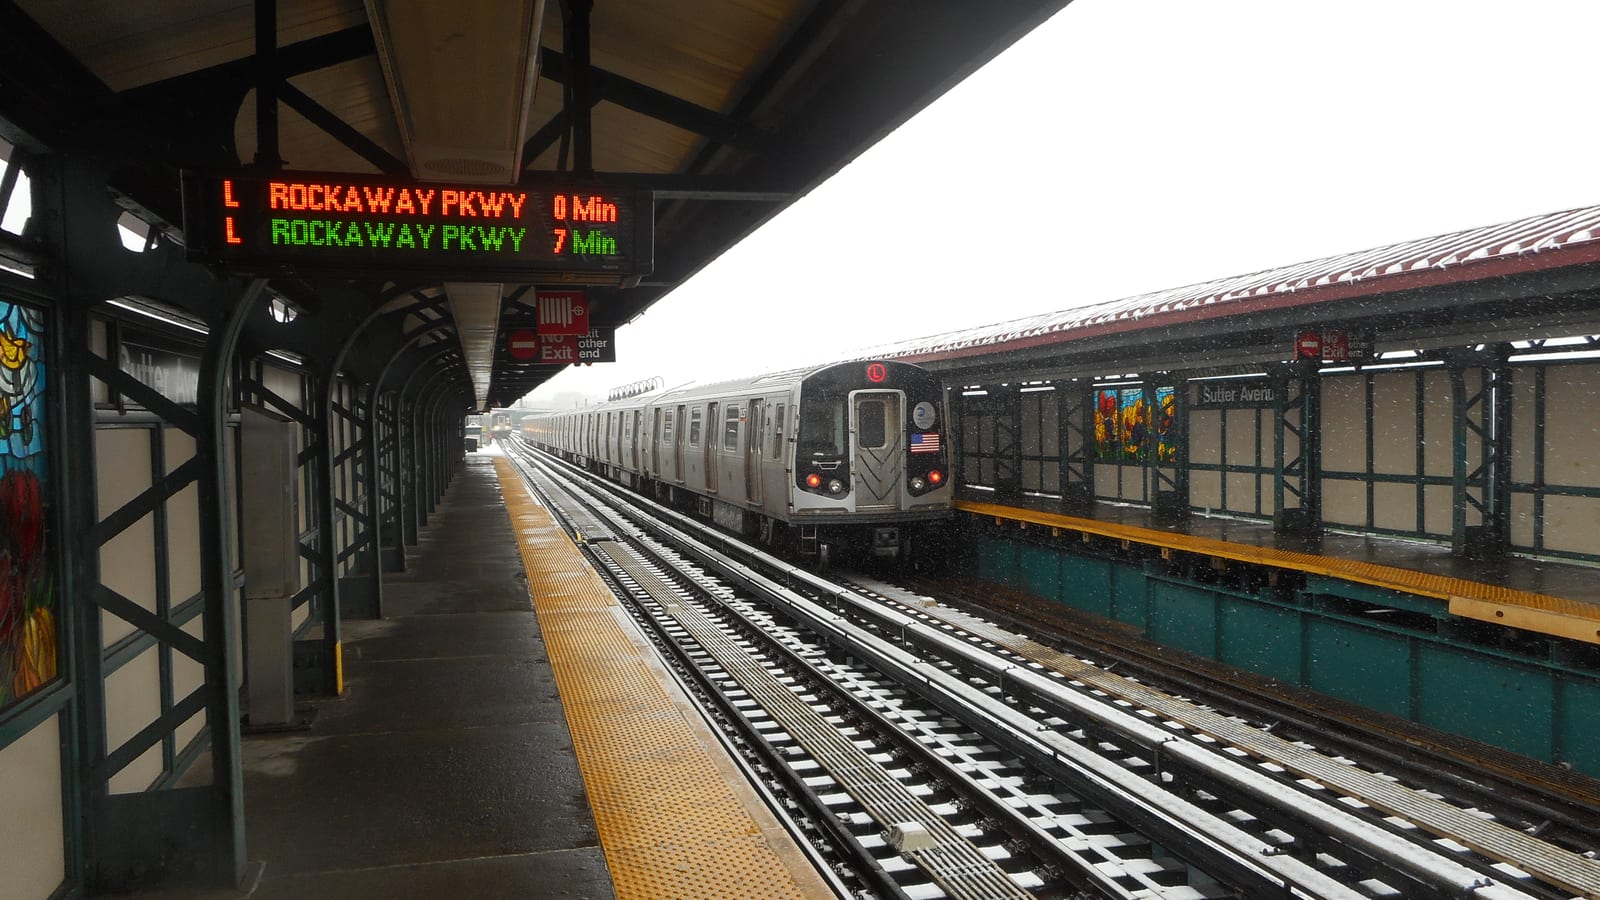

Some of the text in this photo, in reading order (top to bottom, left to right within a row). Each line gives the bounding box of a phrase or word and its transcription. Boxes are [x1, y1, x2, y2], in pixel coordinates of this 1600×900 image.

[223, 180, 616, 222] L ROCKAWAY PKWY 0 Min
[226, 217, 616, 255] L ROCKAWAY PKWY 7 Min
[578, 328, 599, 339] xit
[578, 338, 608, 348] other
[542, 345, 573, 360] Exit
[578, 348, 600, 359] end
[1322, 345, 1345, 358] Exit
[1203, 385, 1275, 403] Sutter Avenu
